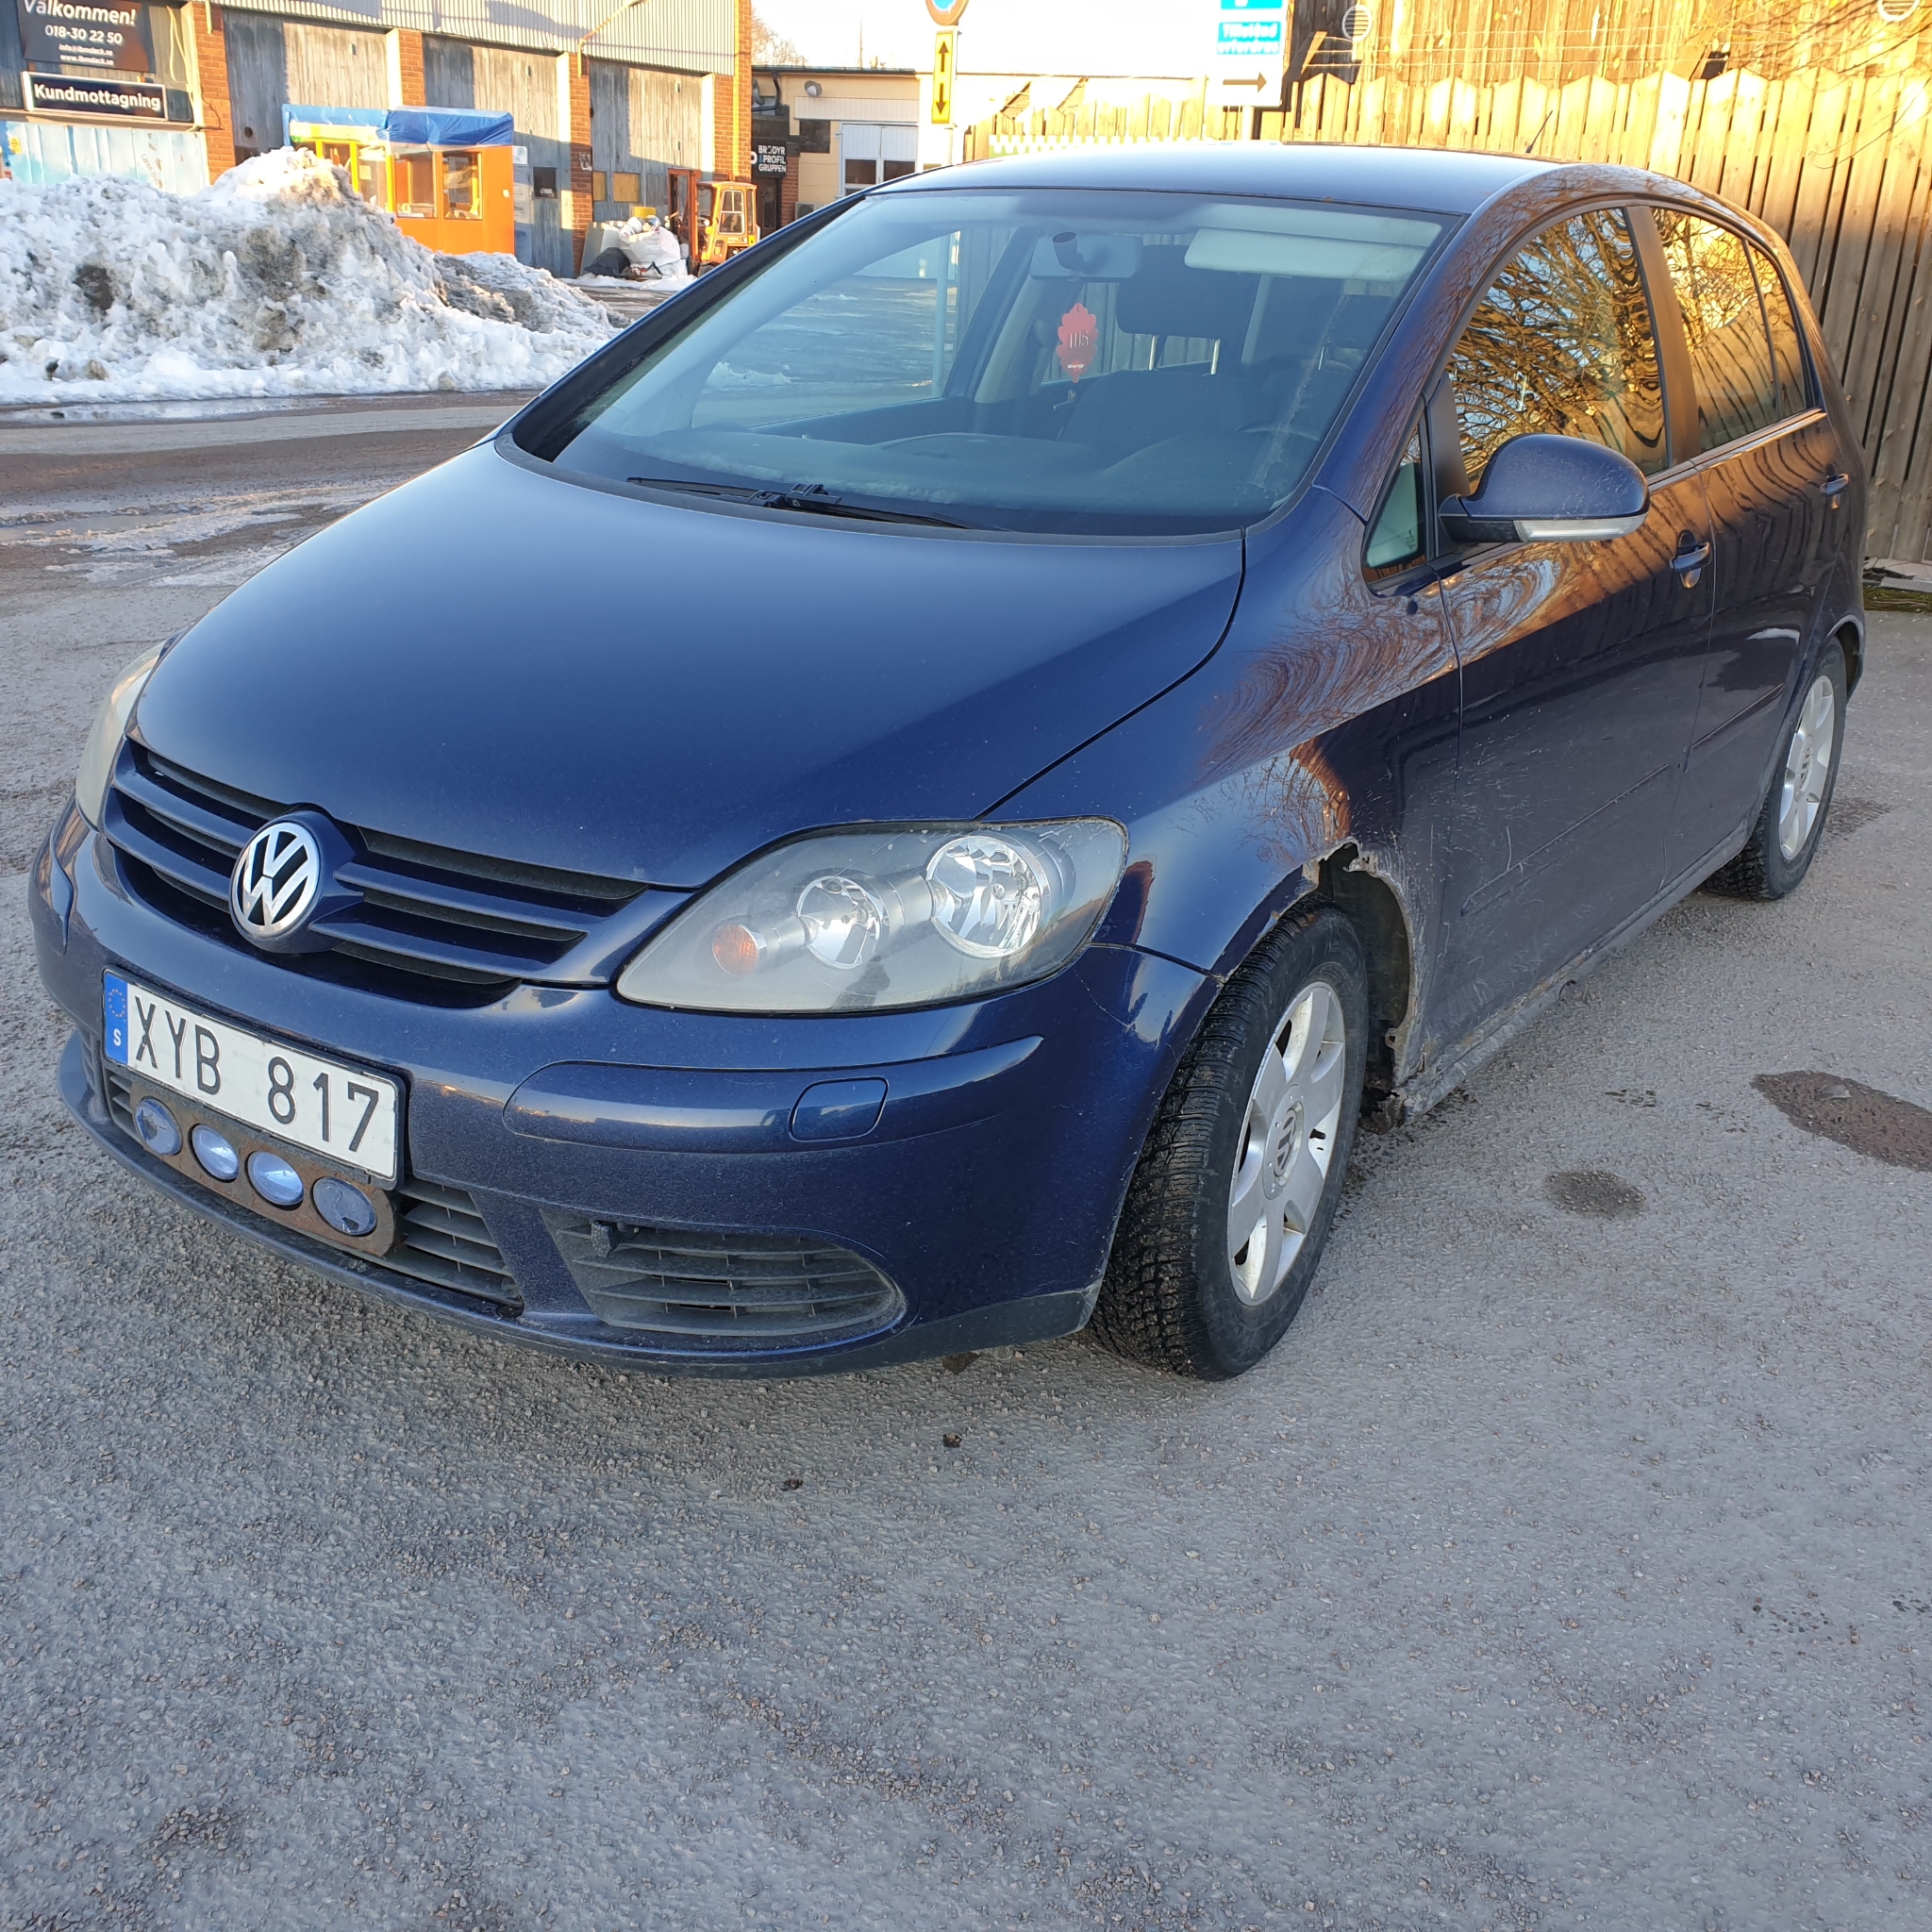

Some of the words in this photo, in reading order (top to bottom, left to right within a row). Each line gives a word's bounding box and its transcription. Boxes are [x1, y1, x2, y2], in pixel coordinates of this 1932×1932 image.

[24, 0, 136, 25] Välkommen!
[44, 25, 87, 40] 018-30
[89, 29, 105, 42] 22
[107, 32, 123, 44] 50
[34, 83, 161, 110] Kundmottagning
[758, 163, 786, 172] GRUPPEN
[763, 155, 786, 163] PROFIL
[112, 1027, 122, 1047] S
[134, 995, 222, 1096] XYB
[267, 1056, 380, 1153] 817
